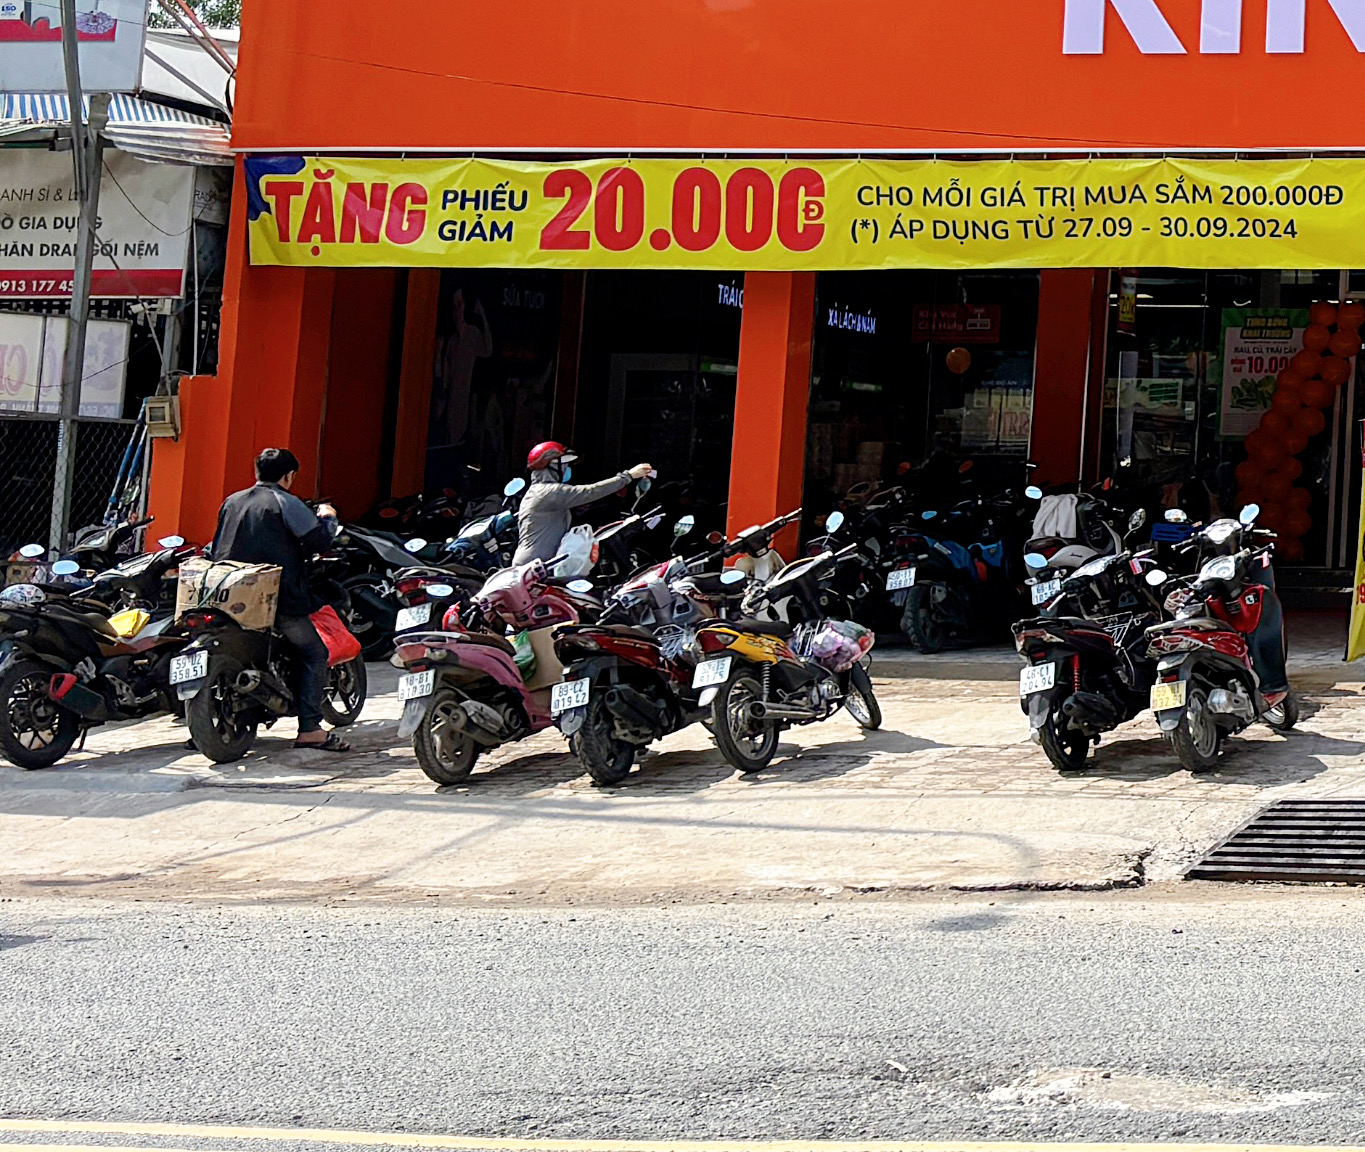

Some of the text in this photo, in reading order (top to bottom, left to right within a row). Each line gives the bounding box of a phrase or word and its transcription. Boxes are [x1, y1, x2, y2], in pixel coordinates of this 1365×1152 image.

[53, 189, 63, 201] &
[441, 180, 529, 213] PHIẾU
[856, 175, 1345, 212] CHO MỖI GIÁ TRỊ MUA SẮM 200.000Đ
[19, 216, 103, 233] GIA DỤG
[265, 169, 428, 256] TẶNG
[437, 214, 514, 243] GIẢM
[887, 212, 924, 239] ÁP
[932, 218, 1010, 246] DỤNG
[1016, 213, 1055, 240] TỪ
[1062, 217, 1133, 238] 27.09
[1158, 216, 1299, 239] 30.09.2024
[39, 243, 78, 257] DRA
[124, 240, 159, 260] NỆM
[31, 280, 56, 292] 177
[58, 280, 75, 292] 45
[1247, 356, 1291, 374] 10.00
